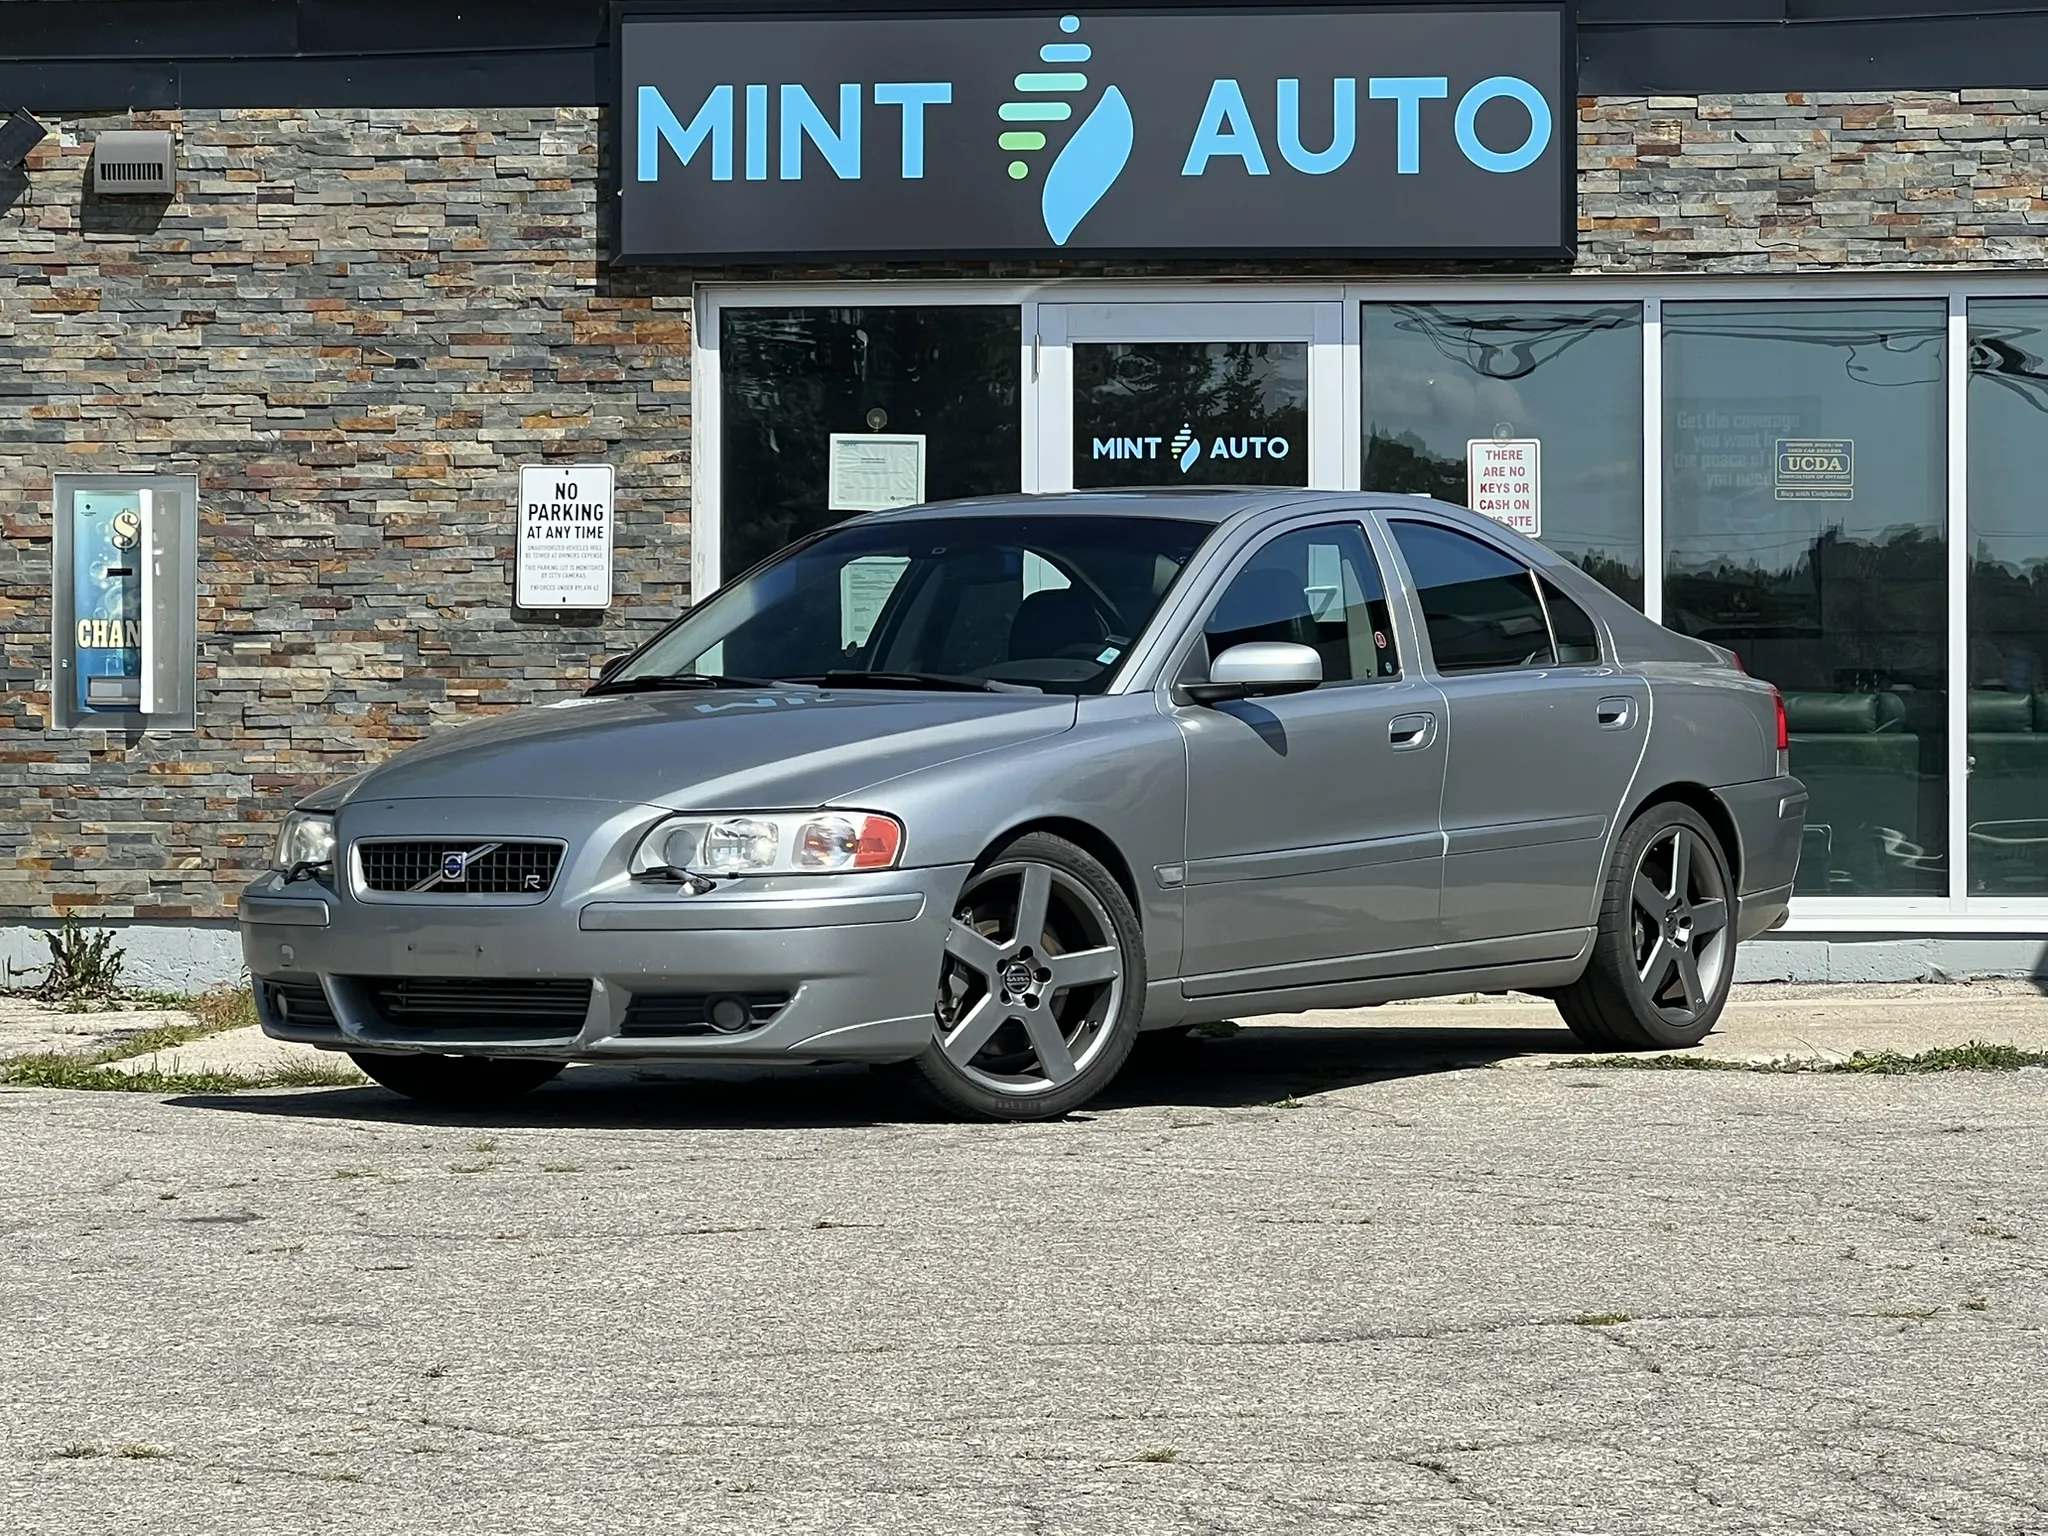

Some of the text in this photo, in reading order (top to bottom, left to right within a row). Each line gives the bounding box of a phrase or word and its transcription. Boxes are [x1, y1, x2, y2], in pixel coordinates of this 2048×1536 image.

[638, 76, 1553, 182] MINT AUTO
[1676, 408, 1800, 432] Get the coverage
[1093, 436, 1289, 459] MINT AUTO
[1693, 434, 1720, 453] you
[1723, 433, 1761, 449] want
[1486, 450, 1523, 460] THERE
[1673, 450, 1698, 469] the
[1702, 455, 1747, 472] peace
[1483, 466, 1526, 477] ARE NO
[1787, 457, 1843, 471] UCDA
[555, 483, 578, 500] NO
[1480, 483, 1530, 494] KEYS OR
[528, 503, 604, 521] PARKING
[1479, 499, 1530, 510] CASH ON
[1507, 516, 1532, 526] SITE
[527, 526, 604, 539] AT ANY TIME
[524, 874, 541, 889] R
